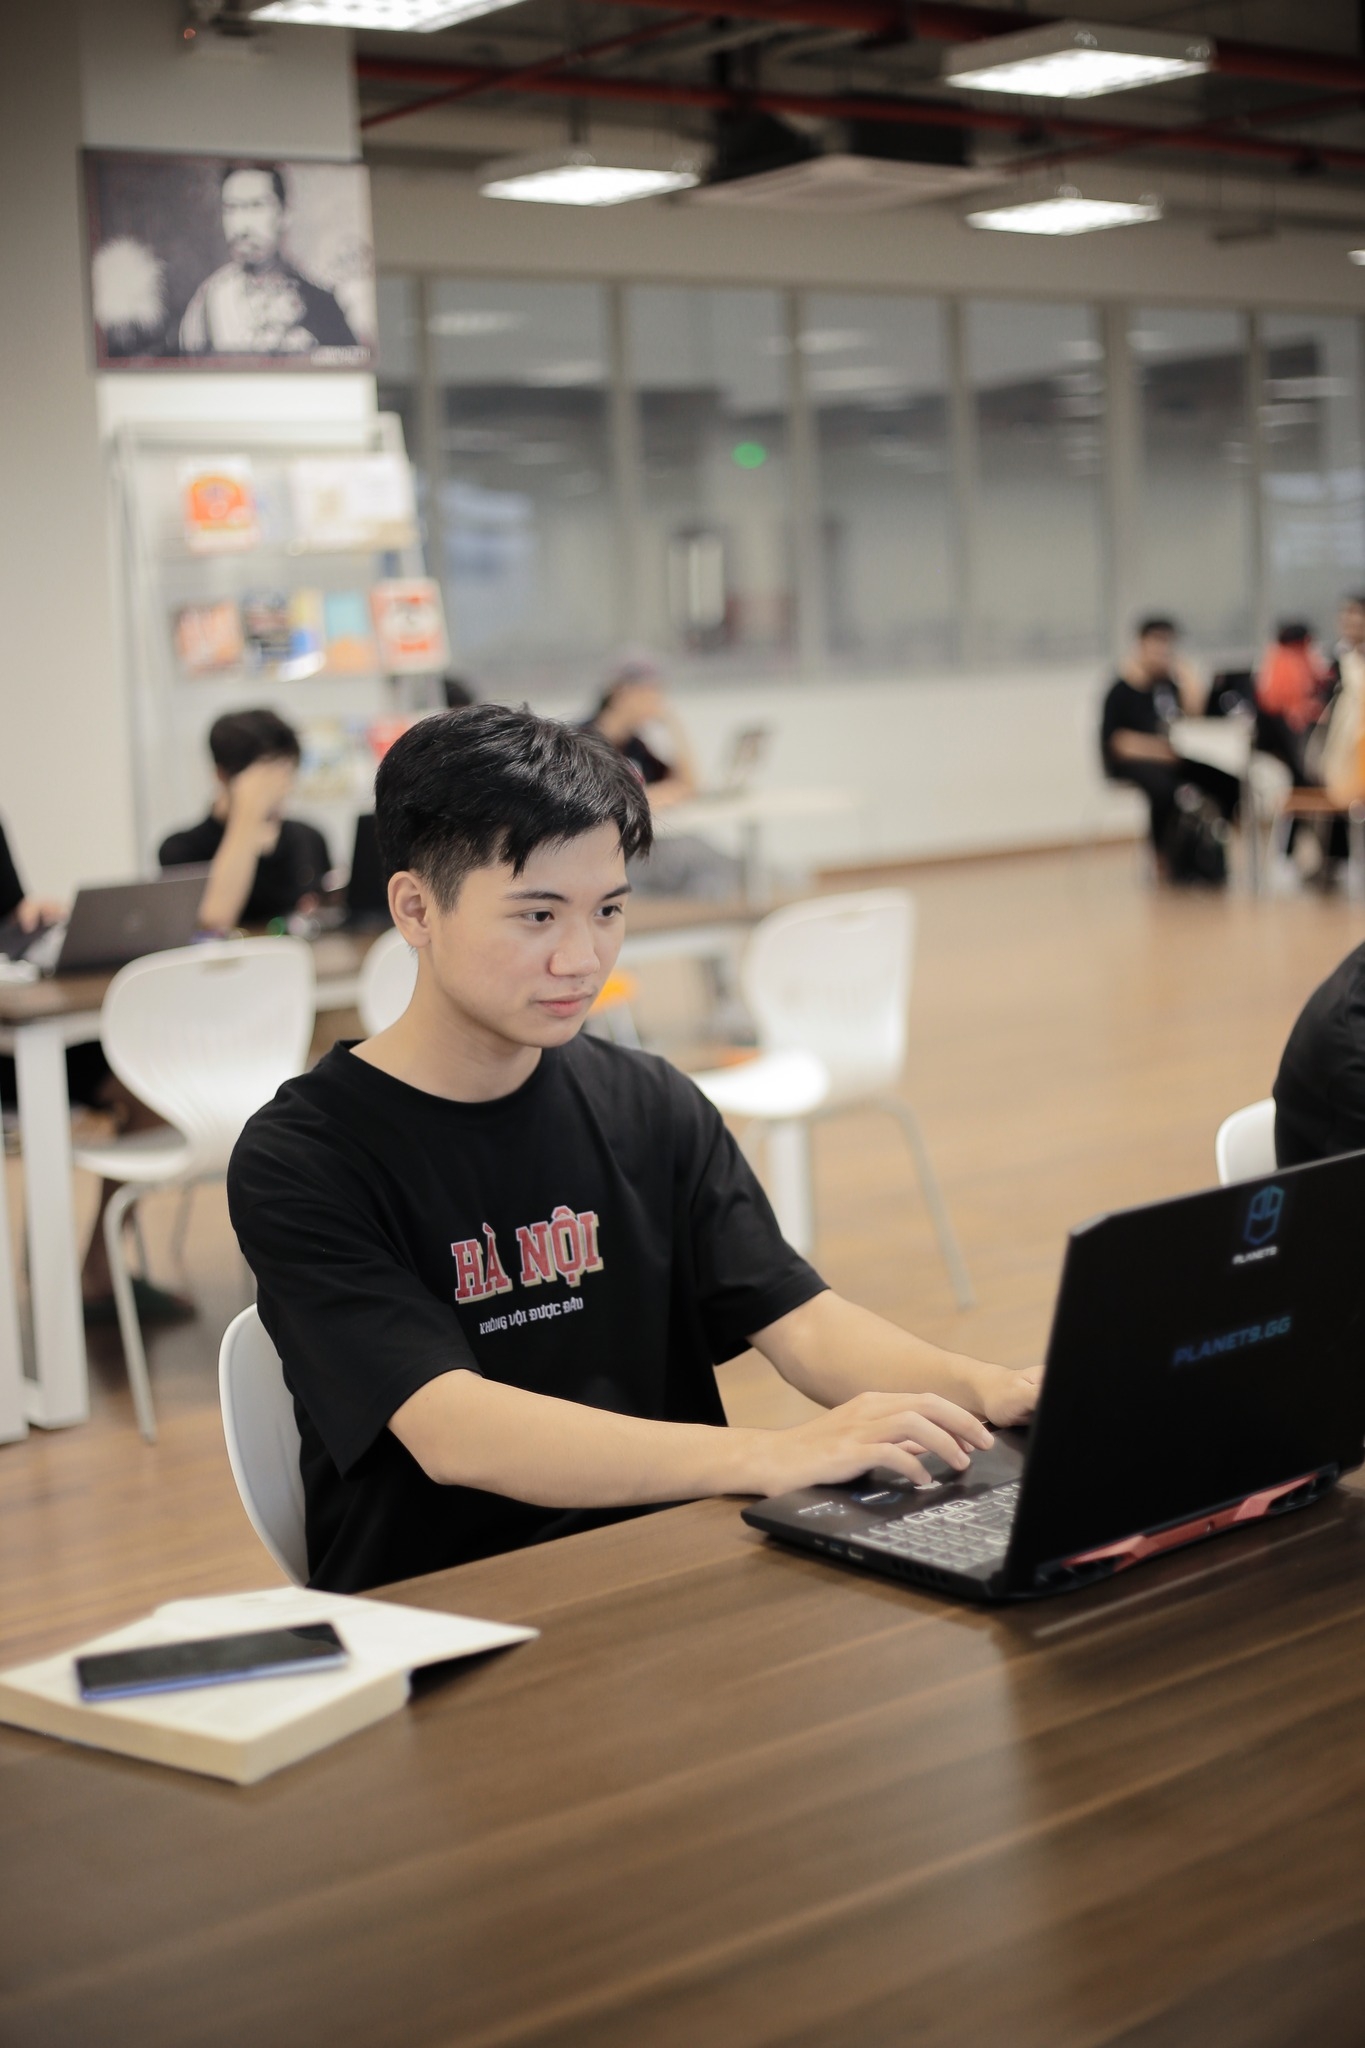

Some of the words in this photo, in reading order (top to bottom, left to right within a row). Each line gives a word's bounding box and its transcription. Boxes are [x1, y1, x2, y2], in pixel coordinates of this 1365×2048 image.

[451, 1222, 513, 1304] HÀ
[515, 1205, 604, 1288] NỘI
[480, 1317, 508, 1335] KHÔNG
[508, 1309, 528, 1326] VỘI
[528, 1303, 562, 1320] ĐƯỢC
